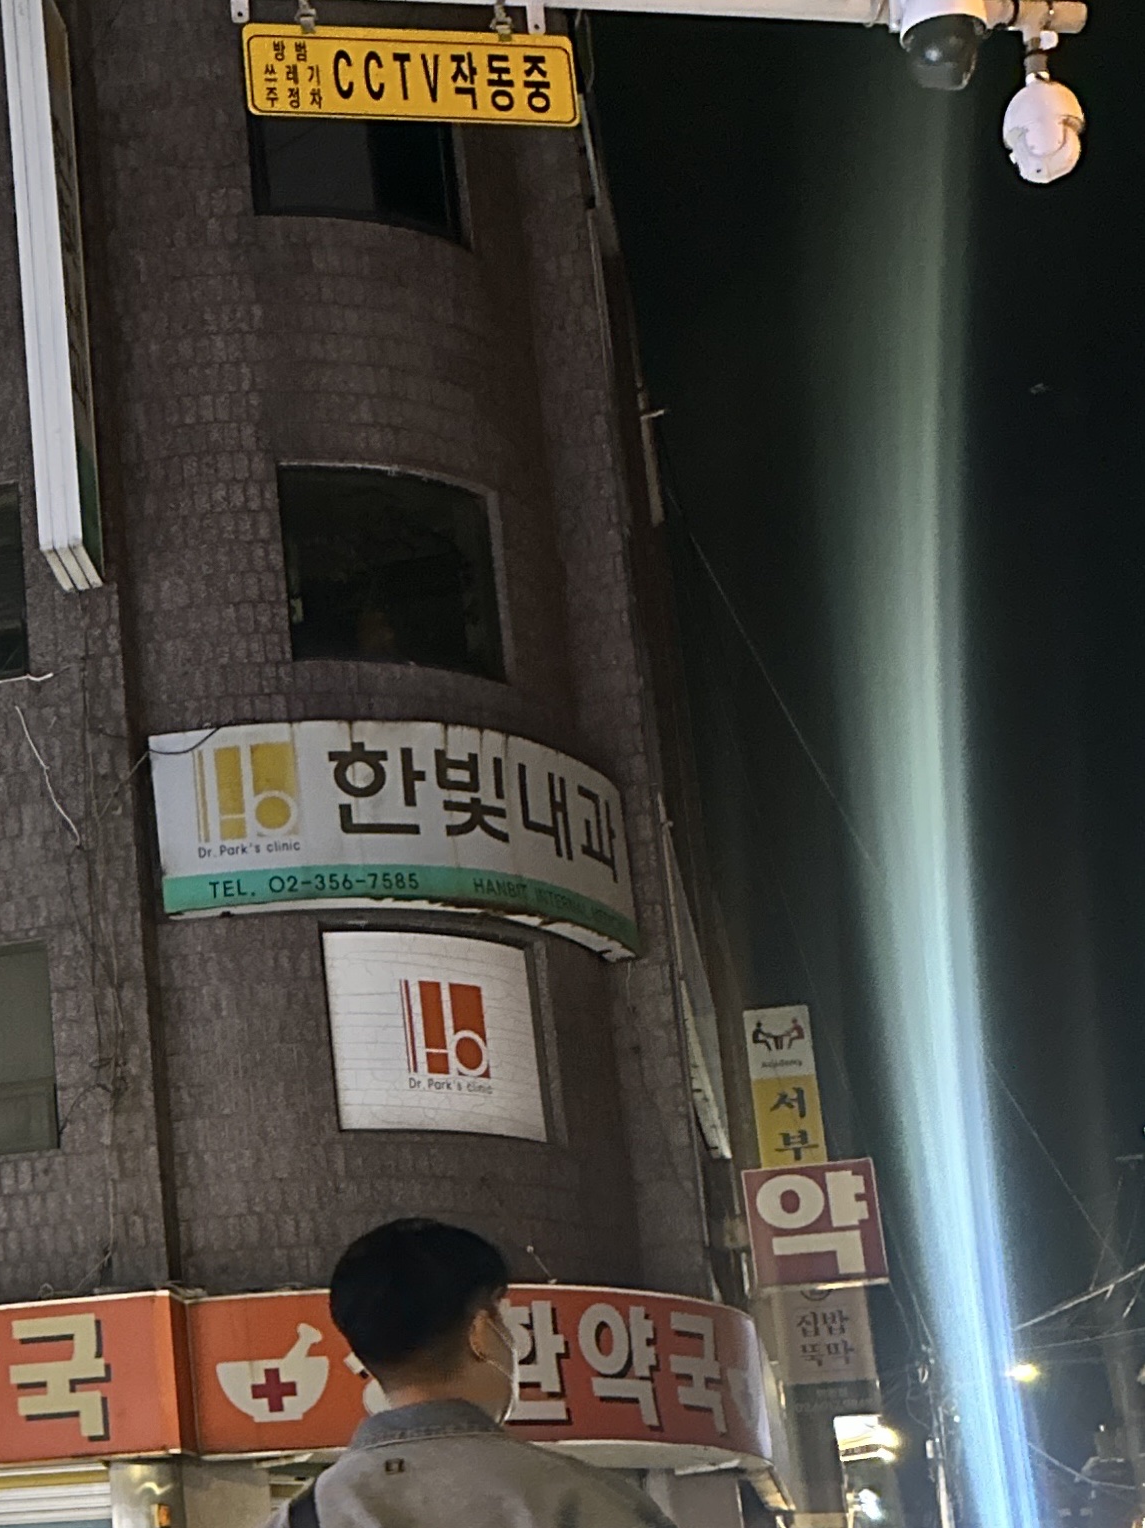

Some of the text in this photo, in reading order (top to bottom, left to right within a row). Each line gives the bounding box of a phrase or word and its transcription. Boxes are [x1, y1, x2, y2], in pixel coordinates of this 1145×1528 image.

[272, 40, 307, 62] 방범
[264, 64, 321, 88] 쓰레기
[333, 49, 552, 114] CCTV작동중
[264, 87, 323, 110] 주정차
[328, 741, 618, 883] 한빛내과
[219, 842, 262, 857] Park's
[266, 840, 301, 854] clinic
[269, 873, 420, 893] 02-356-7585
[473, 878, 527, 898] HANBIT
[756, 1170, 869, 1275] 약
